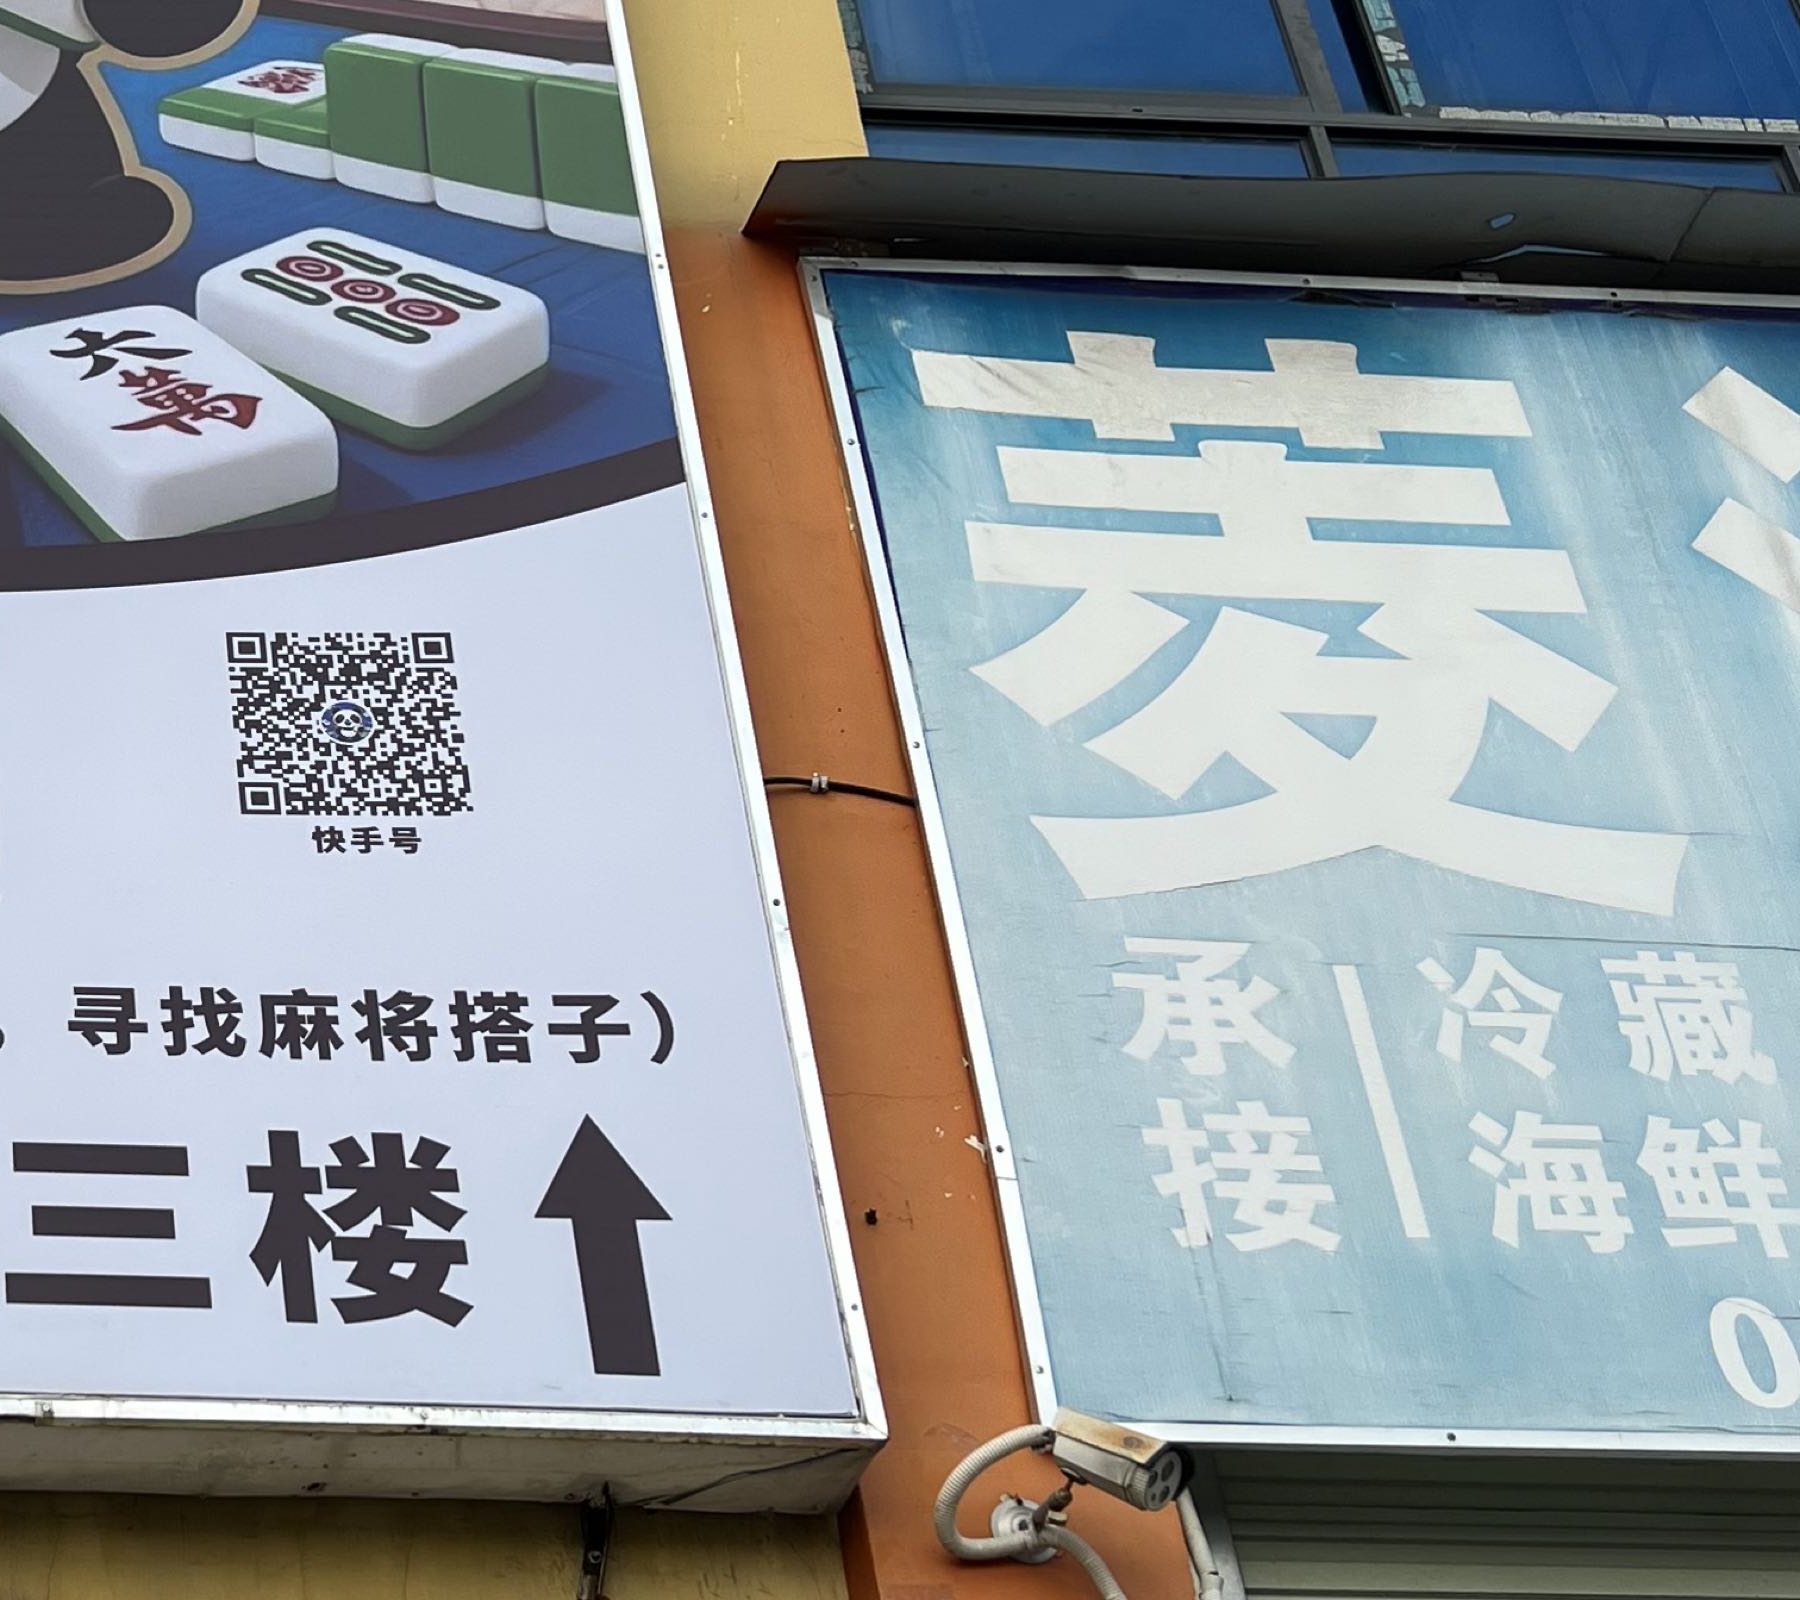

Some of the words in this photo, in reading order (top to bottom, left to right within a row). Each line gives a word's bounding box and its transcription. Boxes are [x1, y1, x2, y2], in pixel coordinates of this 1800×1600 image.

[311, 825, 423, 856] 快手号
[1417, 946, 1778, 1085] 冷藏
[1111, 935, 1342, 1253] 承接
[1467, 1110, 1800, 1259] 海鲜
